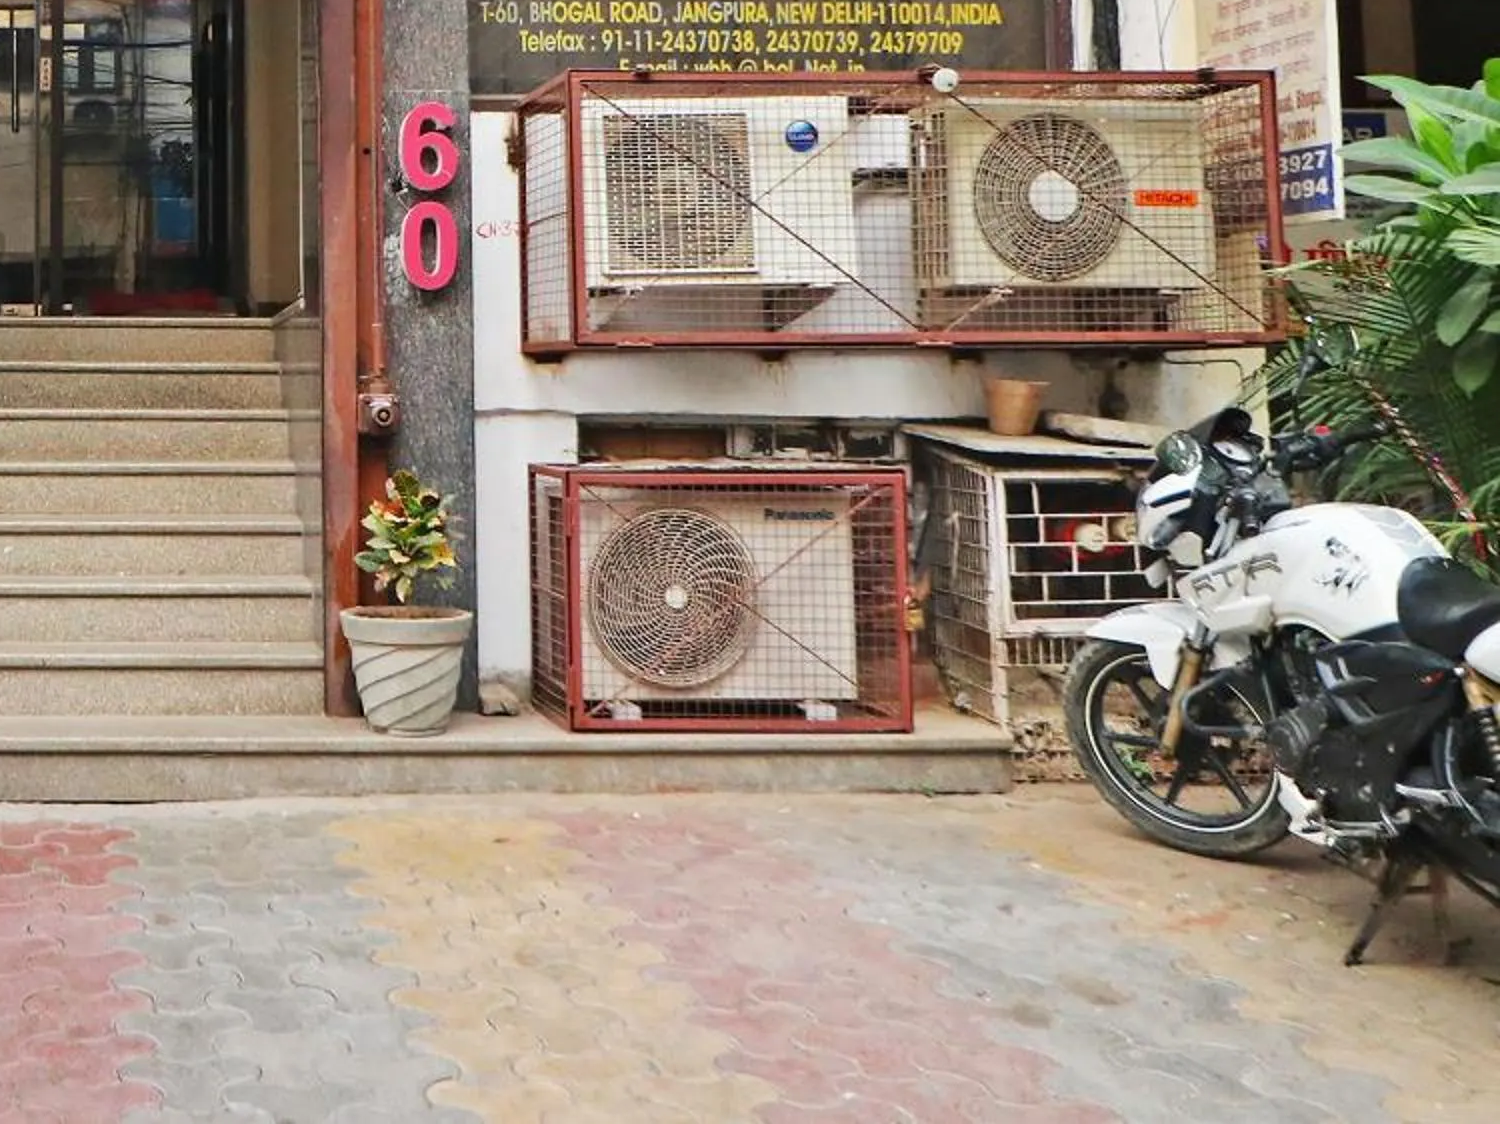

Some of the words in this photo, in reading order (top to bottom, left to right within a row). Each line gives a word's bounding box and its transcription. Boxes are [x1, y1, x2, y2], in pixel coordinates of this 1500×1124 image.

[529, 1, 605, 24] BHOGAL
[609, 1, 668, 26] ROAD,
[776, 2, 818, 25] NEW
[519, 29, 585, 53] Telefax
[766, 31, 865, 55] 24370739,
[870, 31, 964, 55] 24379709
[763, 507, 835, 521] Panasonic
[1191, 552, 1283, 598] RTR
